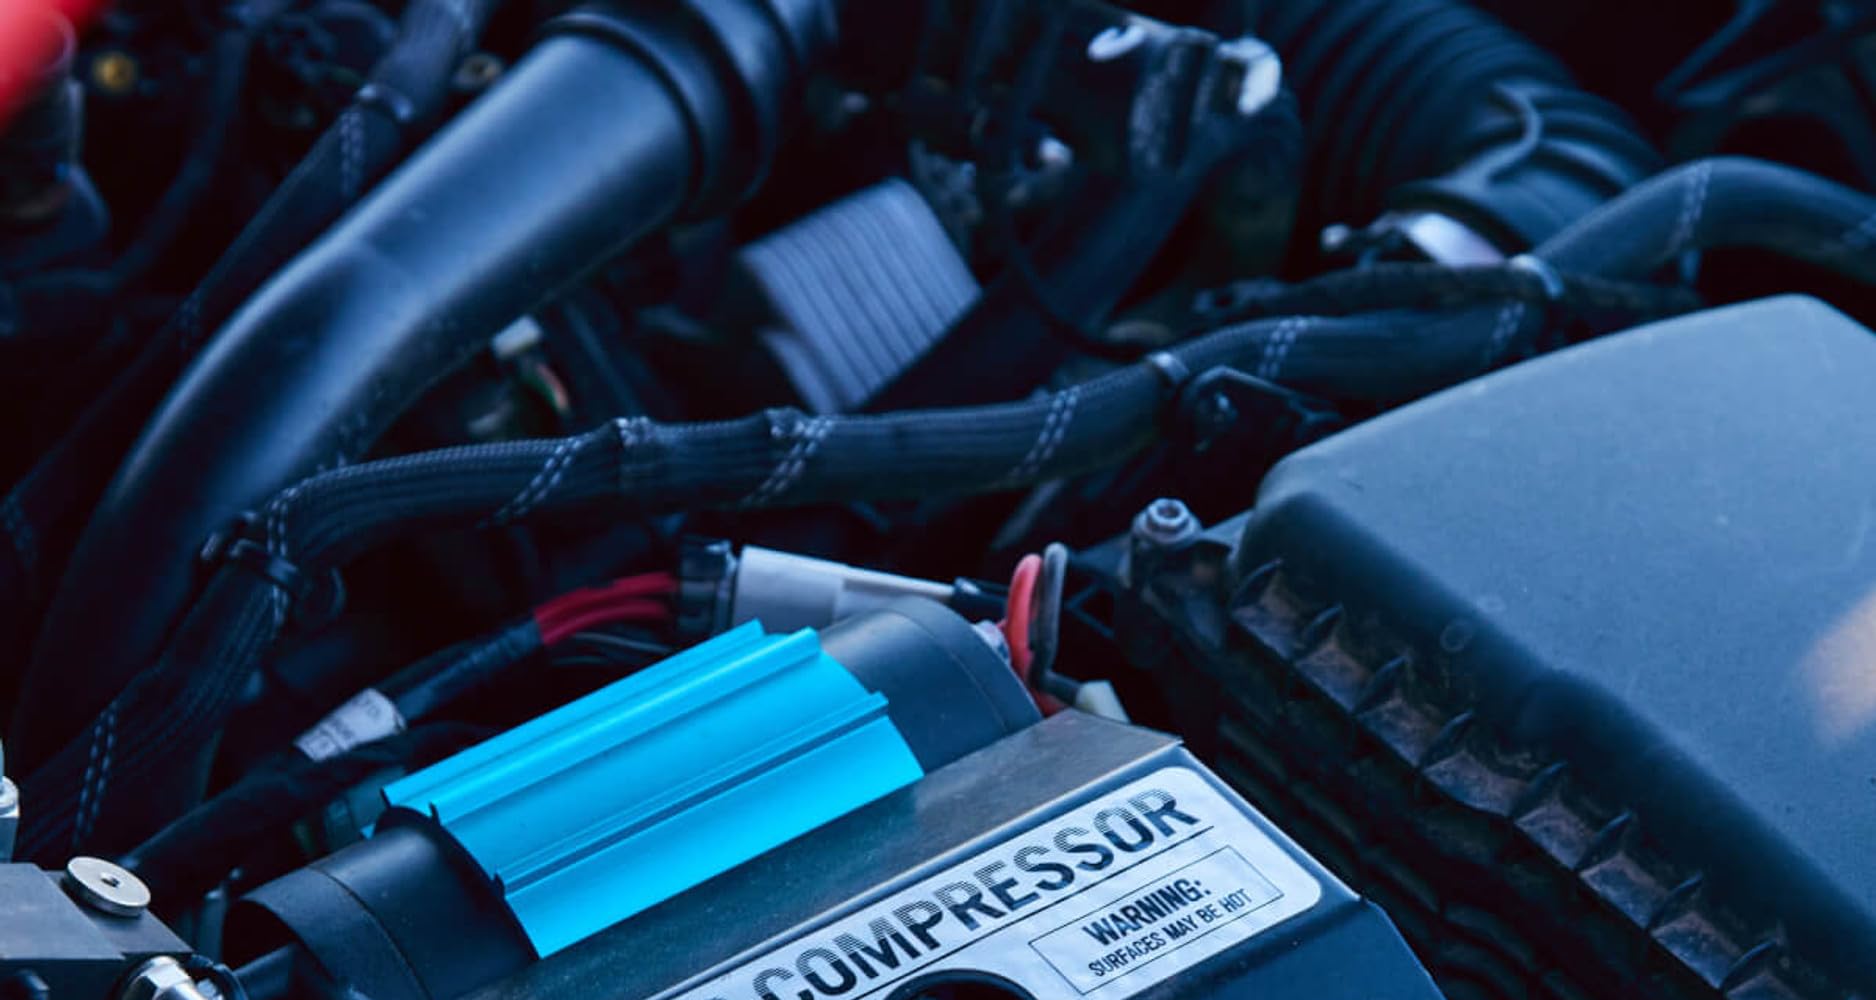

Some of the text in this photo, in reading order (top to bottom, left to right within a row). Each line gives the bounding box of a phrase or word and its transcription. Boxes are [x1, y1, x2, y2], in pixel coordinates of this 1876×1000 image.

[1082, 879, 1212, 946] WARNING:
[1088, 888, 1252, 977] SURFACES MAY BE HOT
